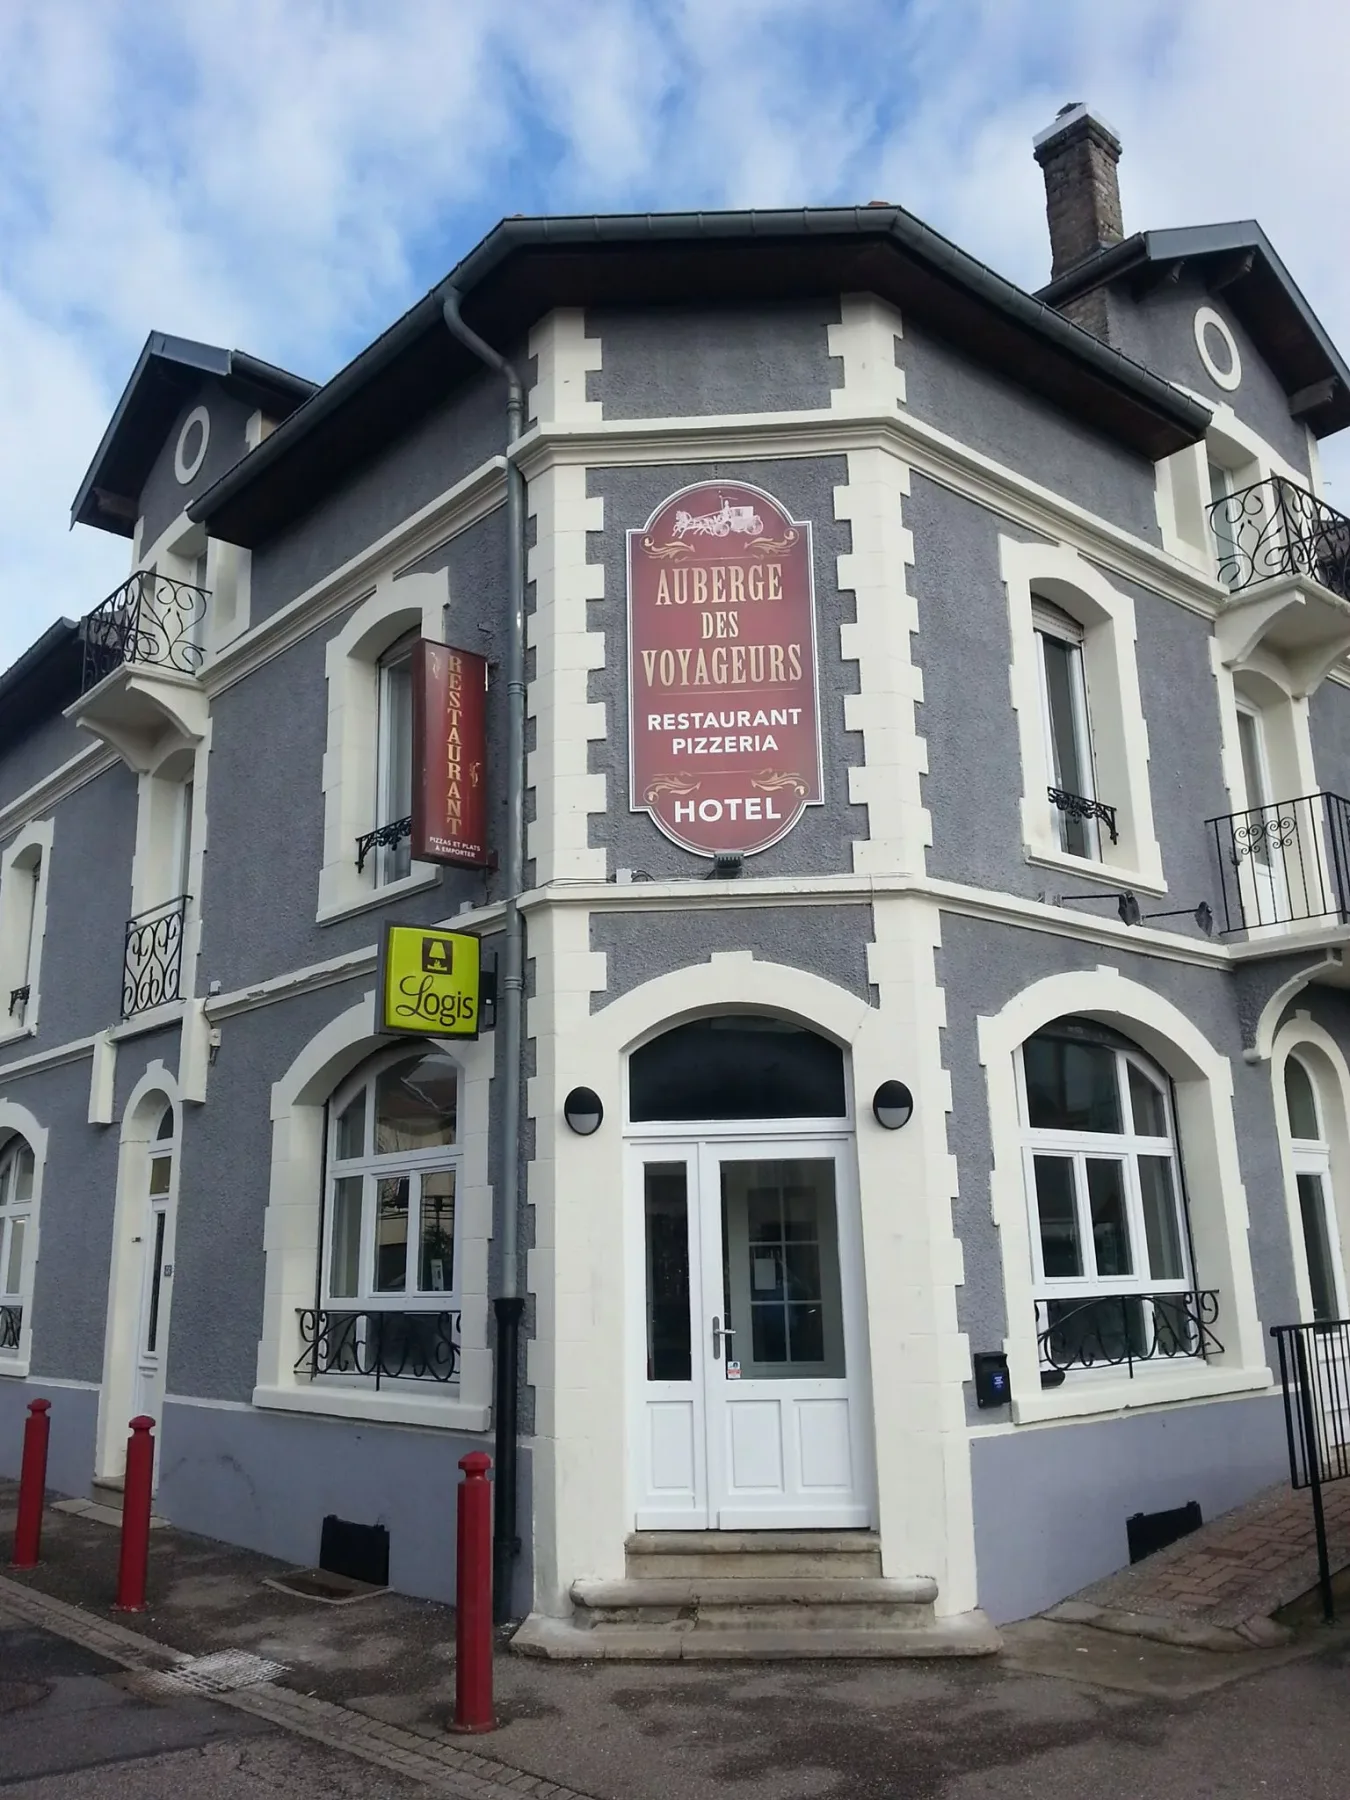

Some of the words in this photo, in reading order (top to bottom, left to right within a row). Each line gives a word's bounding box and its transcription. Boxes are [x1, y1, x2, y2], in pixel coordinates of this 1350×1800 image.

[655, 563, 783, 605] AUBERGE
[701, 611, 739, 639] DES
[641, 643, 803, 687] VOYAGEURS
[647, 708, 802, 730] RESTAURANT
[447, 655, 462, 835] RESTAURANT
[672, 735, 778, 755] PIZZERIA
[674, 797, 781, 823] HOTEL
[429, 836, 451, 846] PIZZAS
[462, 843, 481, 852] PLATS
[441, 846, 476, 858] EMPORTER
[395, 975, 474, 1027] Logis
